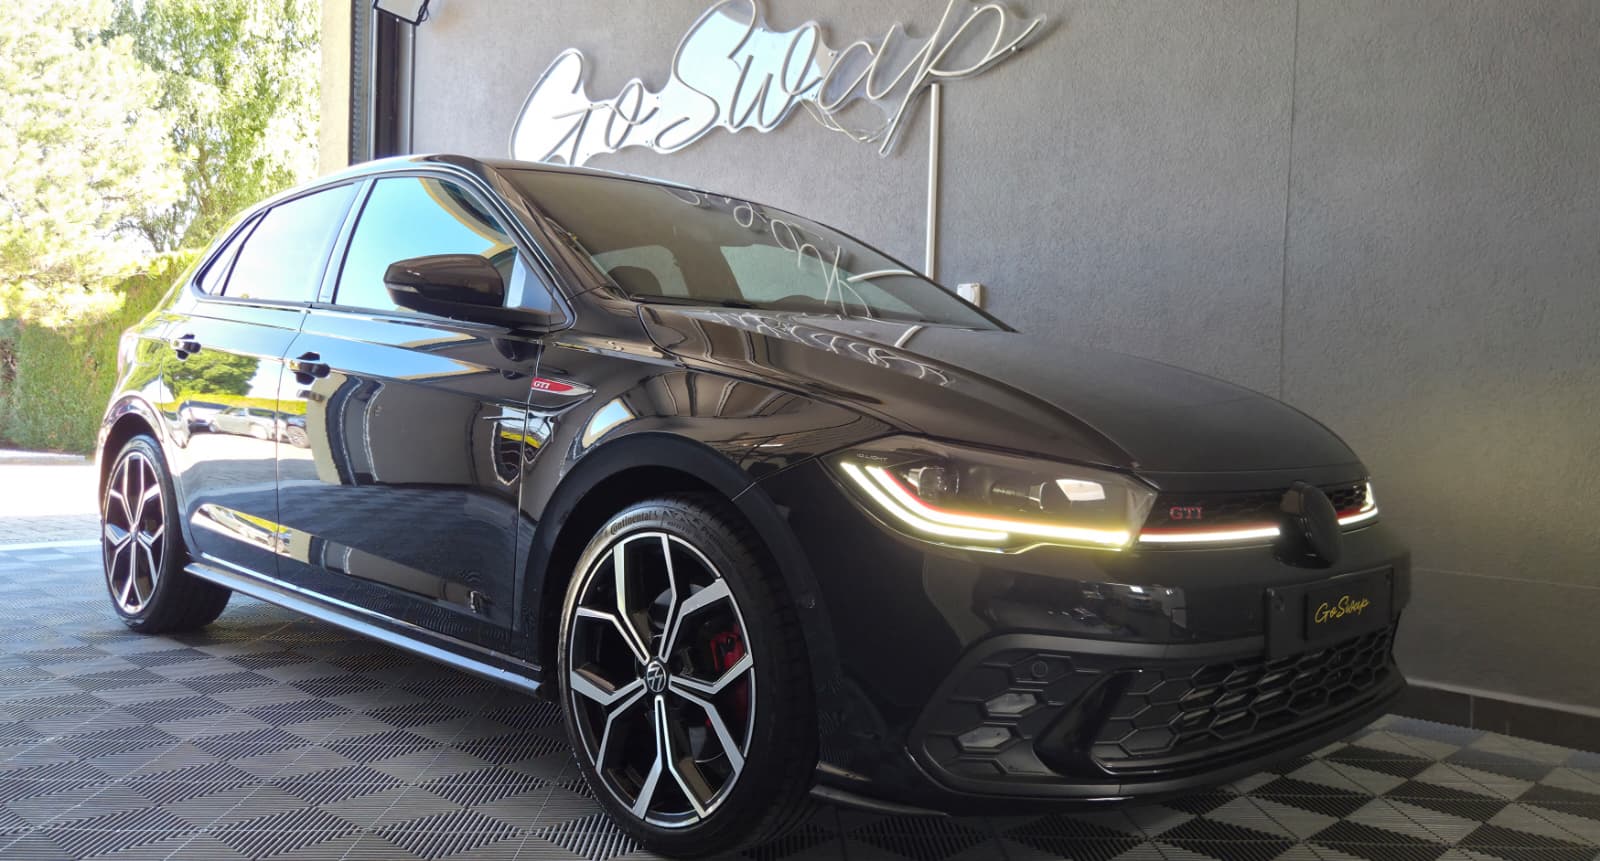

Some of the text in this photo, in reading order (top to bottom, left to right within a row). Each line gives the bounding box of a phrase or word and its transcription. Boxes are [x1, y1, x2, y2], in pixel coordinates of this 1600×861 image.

[508, 0, 1041, 165] GoSwap
[533, 380, 550, 389] GTI
[610, 510, 652, 535] Continental
[1169, 505, 1203, 520] GTI
[1314, 595, 1370, 624] GoSwap
